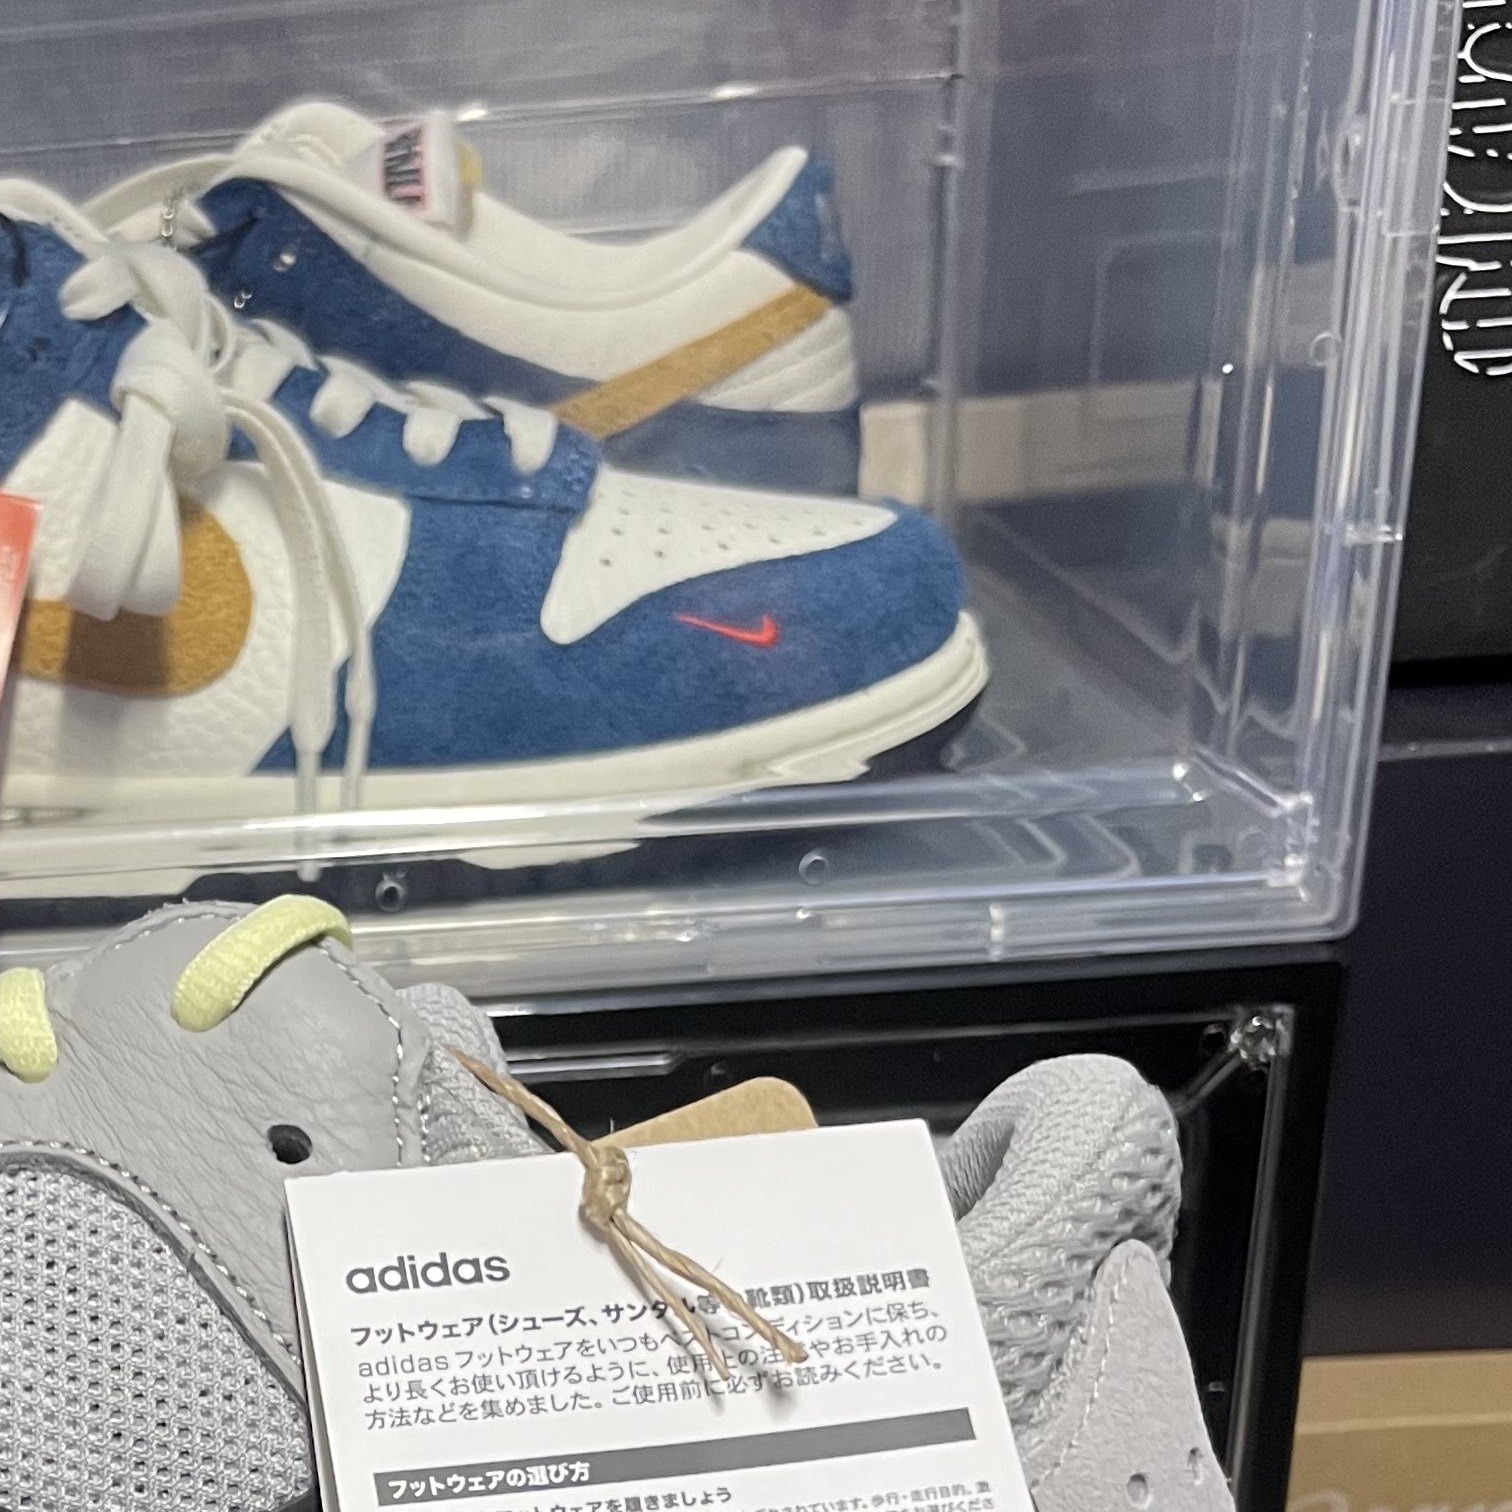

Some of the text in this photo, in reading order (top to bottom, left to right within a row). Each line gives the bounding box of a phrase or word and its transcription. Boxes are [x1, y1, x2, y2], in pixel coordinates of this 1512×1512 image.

[345, 1251, 511, 1294] adidas
[358, 1354, 449, 1378] adidas
[363, 1324, 947, 1404] より長くお使い頂けるように、使用上の注やお手入れの
[388, 1461, 591, 1500] フットウェアの選び方
